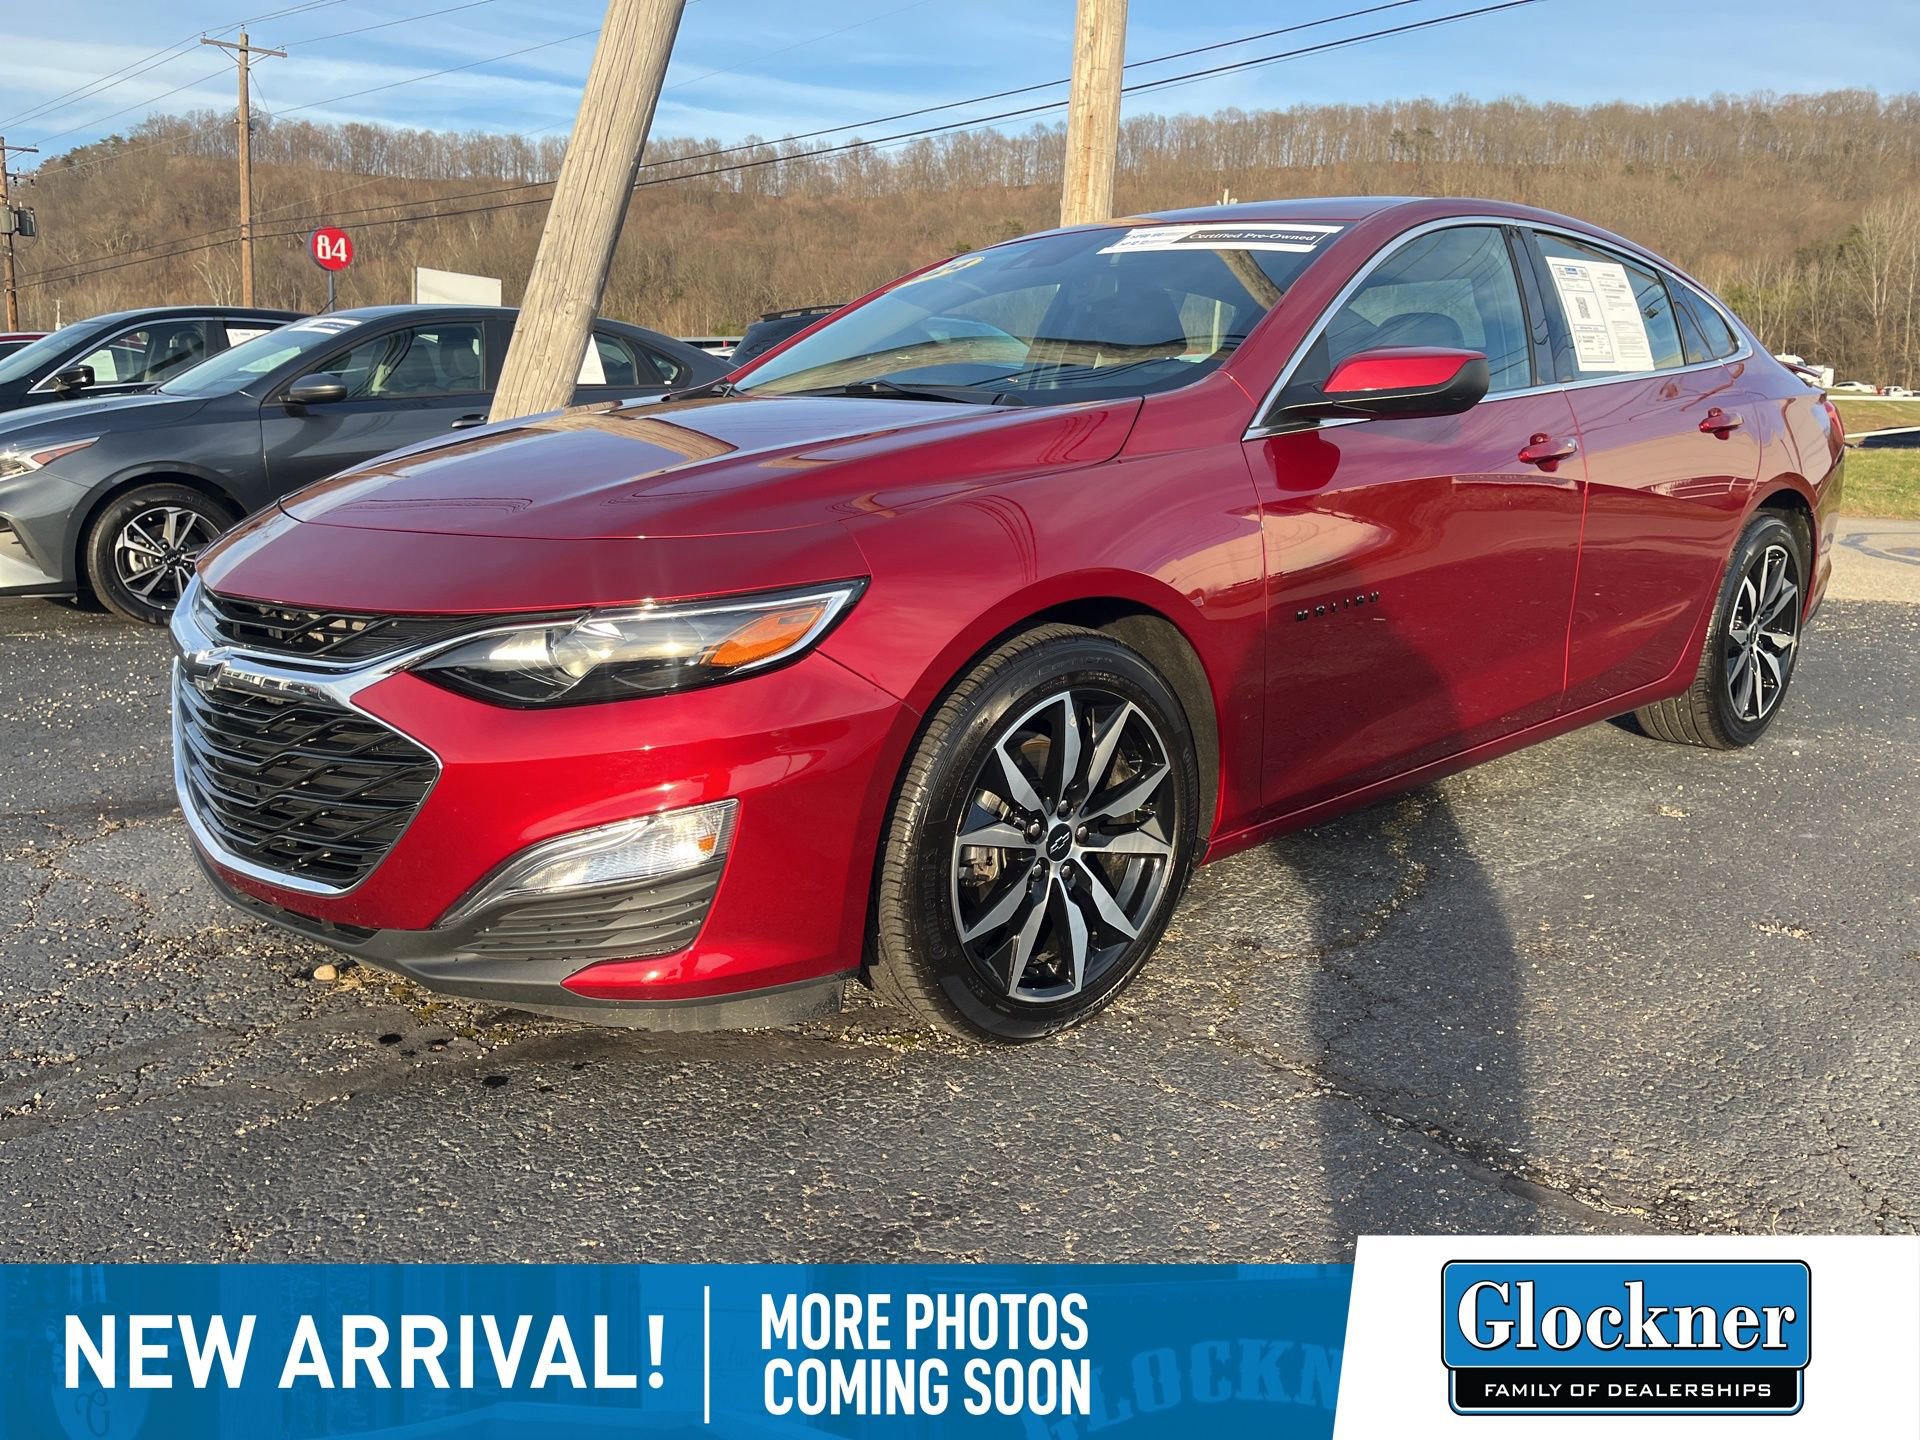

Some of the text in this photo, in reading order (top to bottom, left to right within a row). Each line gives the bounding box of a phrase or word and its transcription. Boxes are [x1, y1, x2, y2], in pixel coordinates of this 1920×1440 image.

[1188, 231, 1317, 242] Certified Pre-Owned
[317, 234, 348, 262] 84
